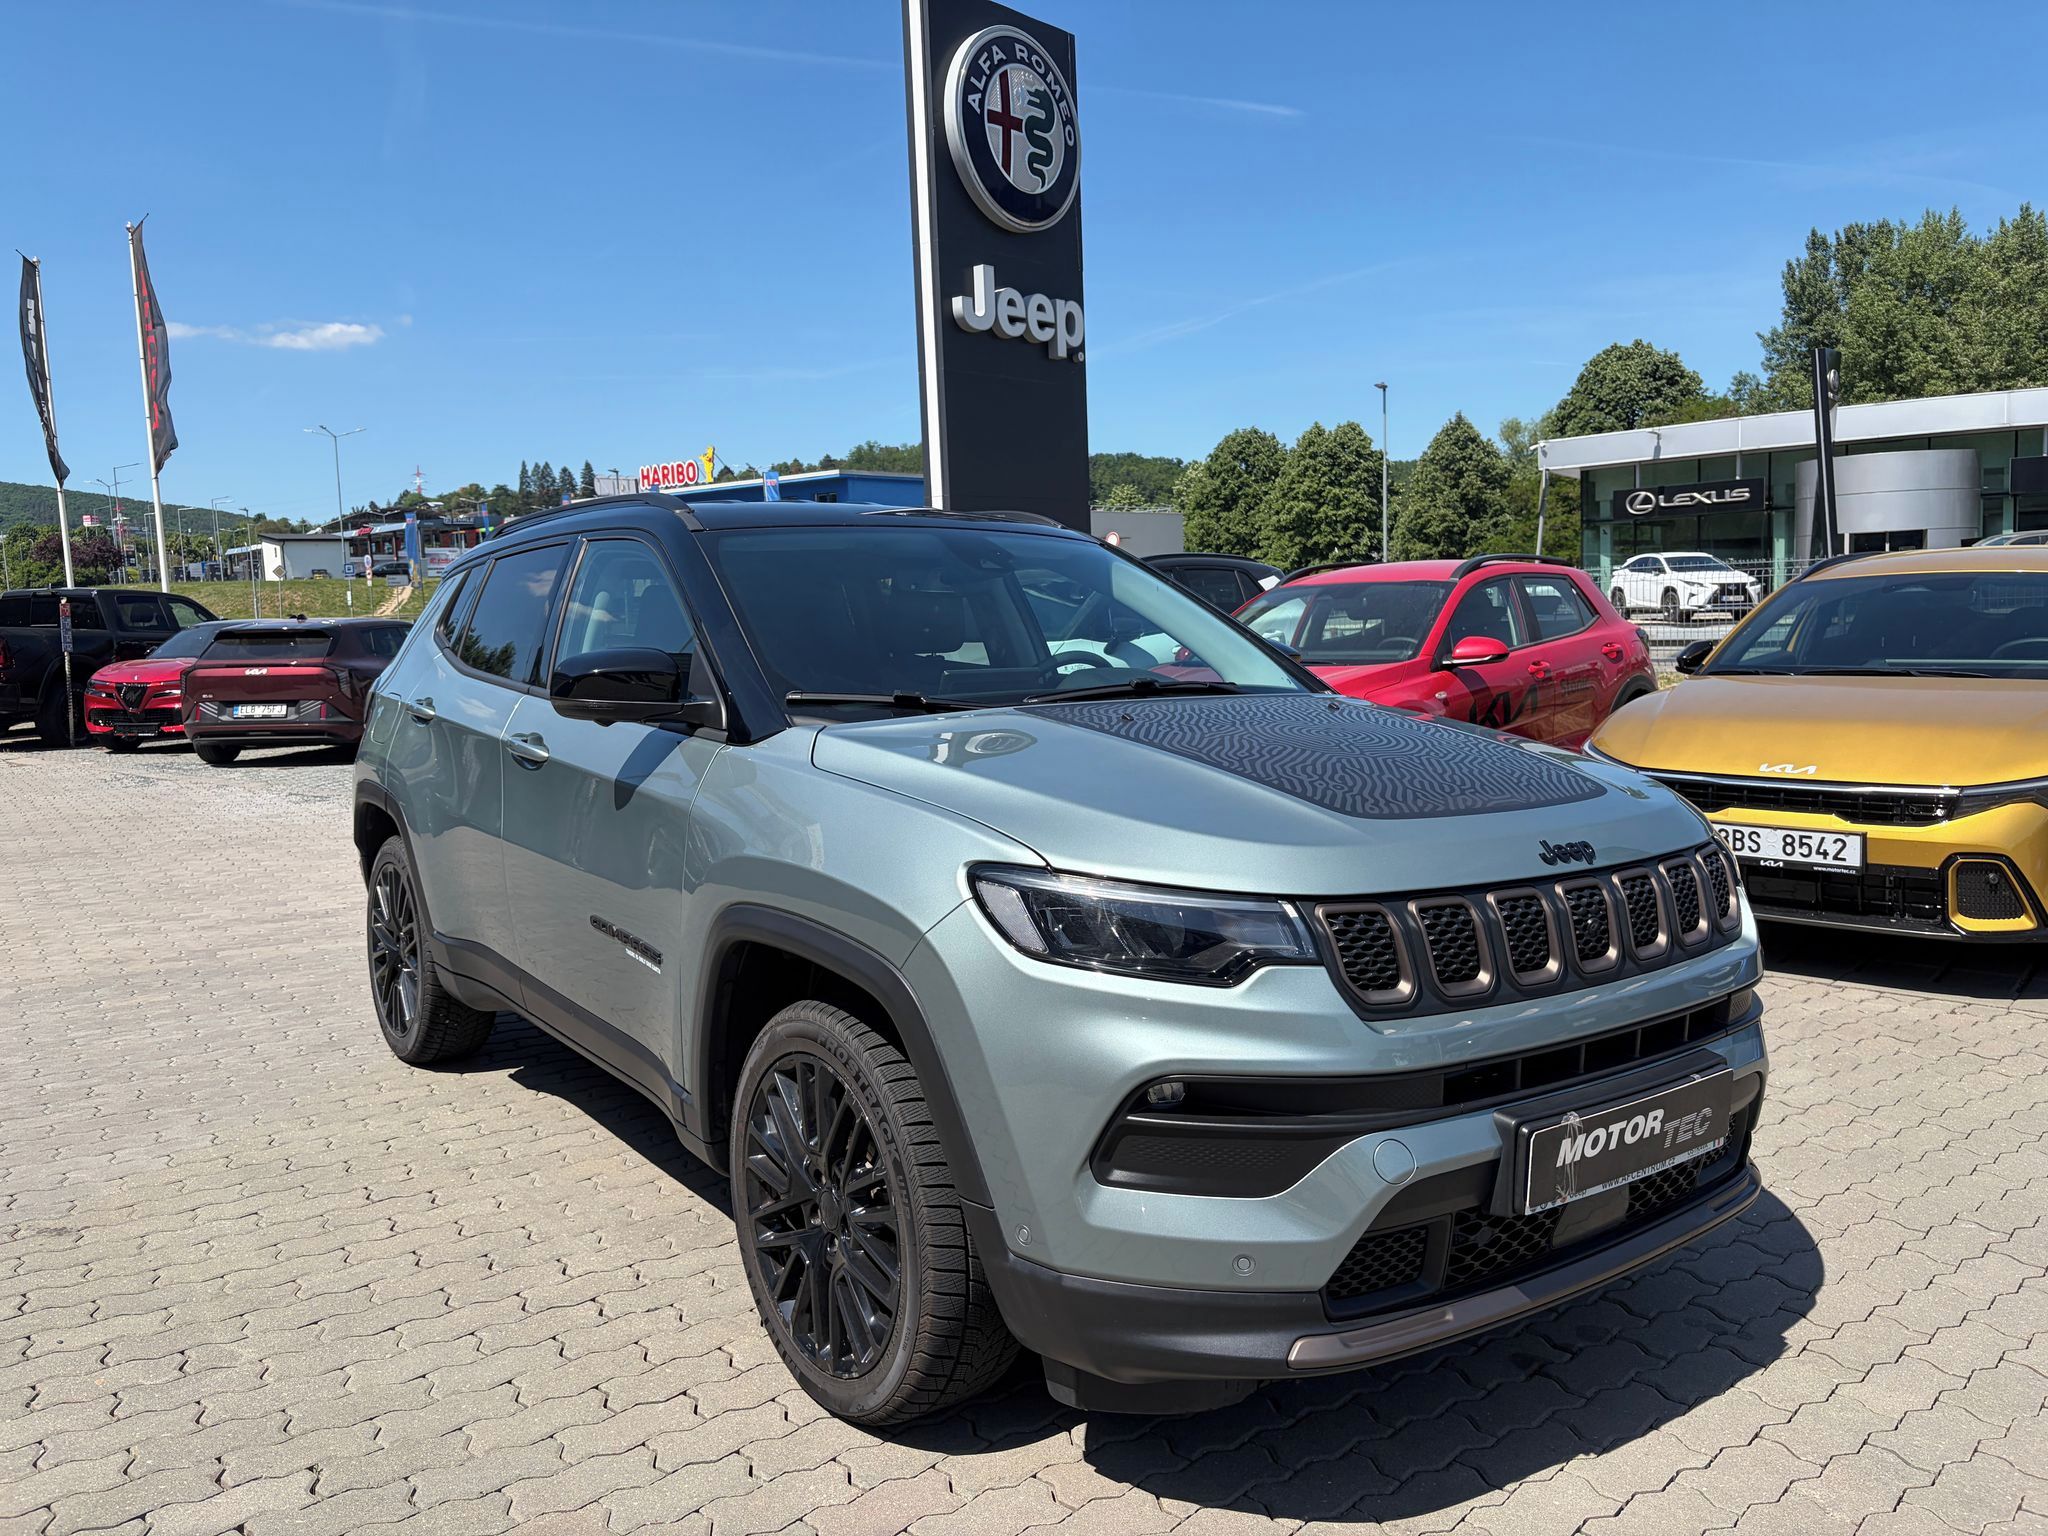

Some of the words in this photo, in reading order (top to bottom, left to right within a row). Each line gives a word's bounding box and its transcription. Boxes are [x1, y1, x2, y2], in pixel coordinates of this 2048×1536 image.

[967, 44, 1007, 115] ALFA
[1014, 42, 1075, 147] ROMEO
[952, 264, 1084, 361] Jeep
[639, 460, 698, 490] HARIBO
[1658, 487, 1750, 507] LEXUS
[1539, 840, 1597, 867] Jeep
[1781, 834, 1848, 862] 8542
[590, 914, 663, 965] COMPASS
[1556, 1108, 1665, 1168] MOTOR
[1663, 1107, 1713, 1149] TEC
